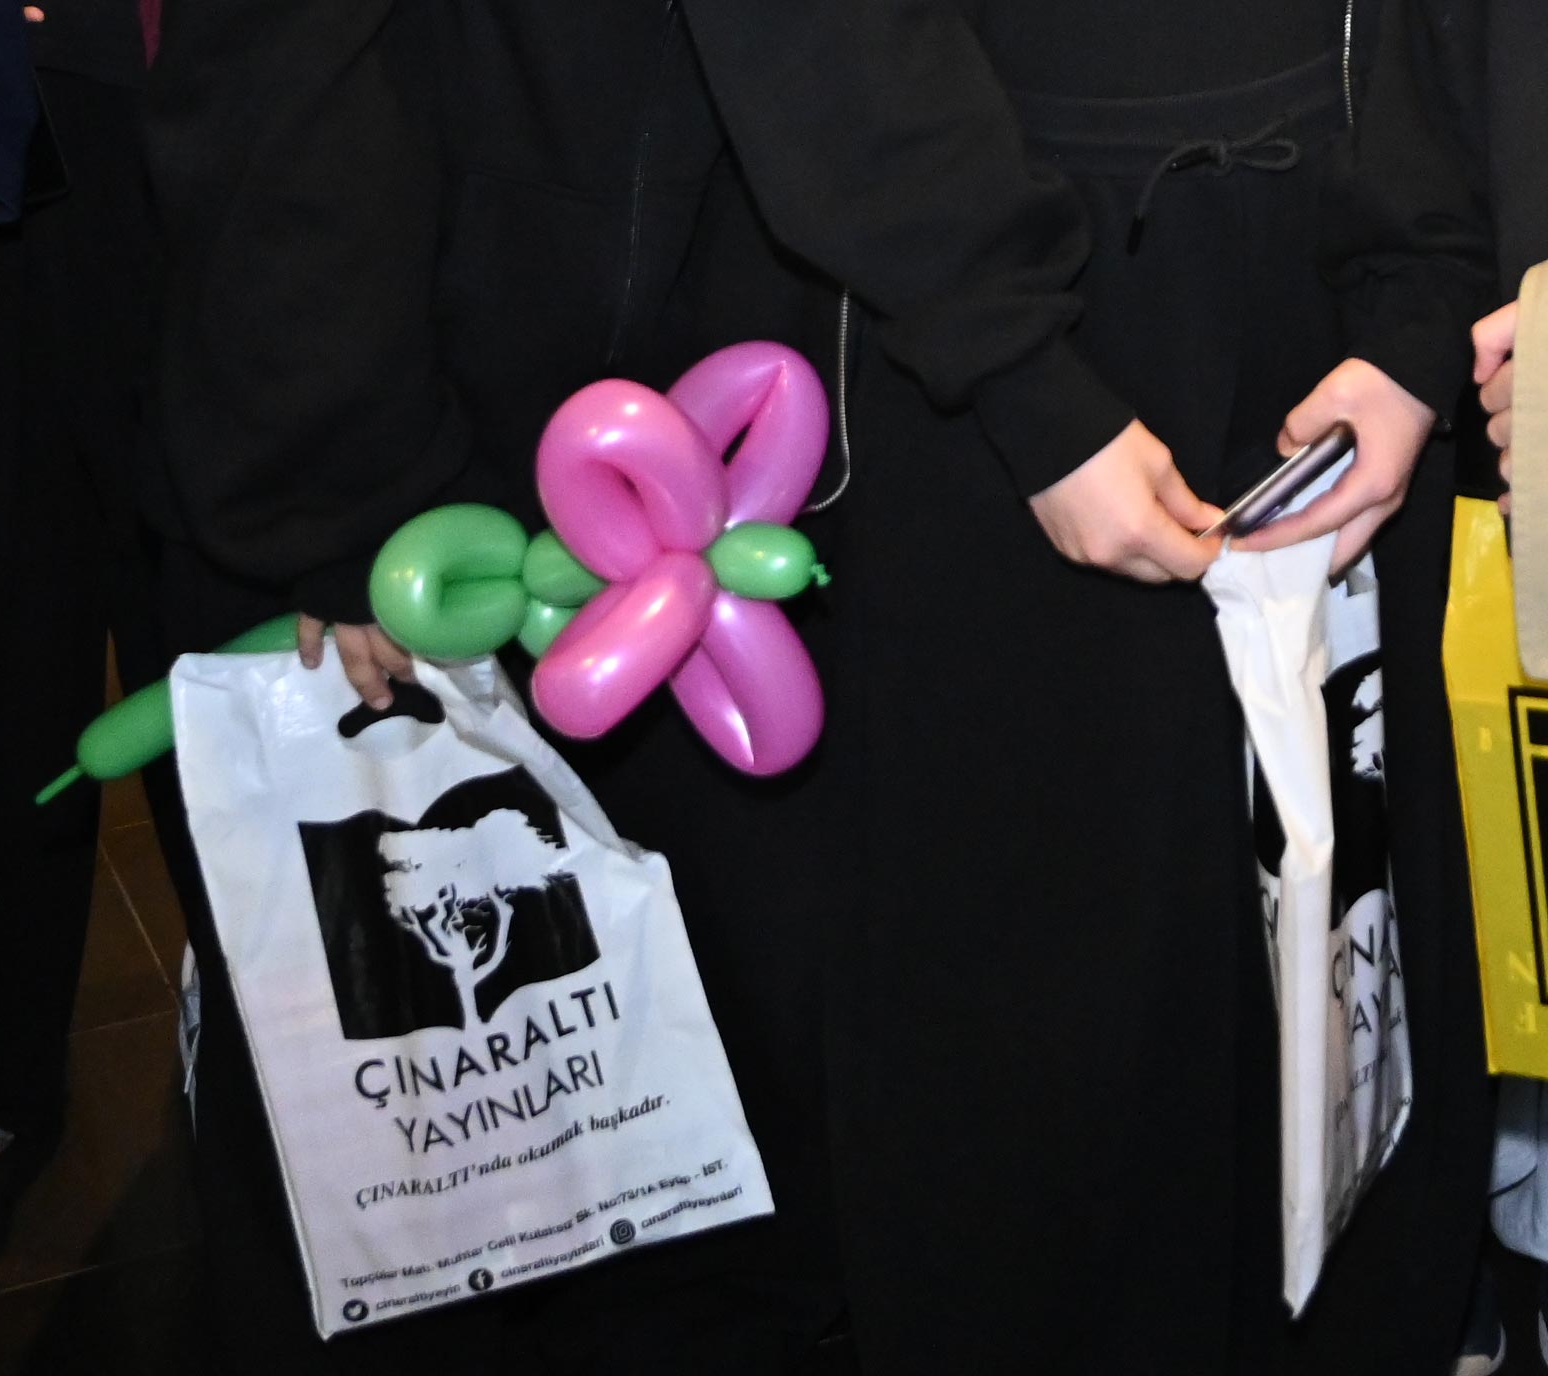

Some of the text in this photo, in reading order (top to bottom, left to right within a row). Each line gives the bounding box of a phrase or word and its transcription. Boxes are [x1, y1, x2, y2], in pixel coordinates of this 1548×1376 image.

[354, 981, 621, 1109] ÇINARALTI
[394, 1050, 605, 1154] YAYINLARI
[517, 1118, 584, 1166] okumak
[590, 1092, 671, 1133] başkadır.
